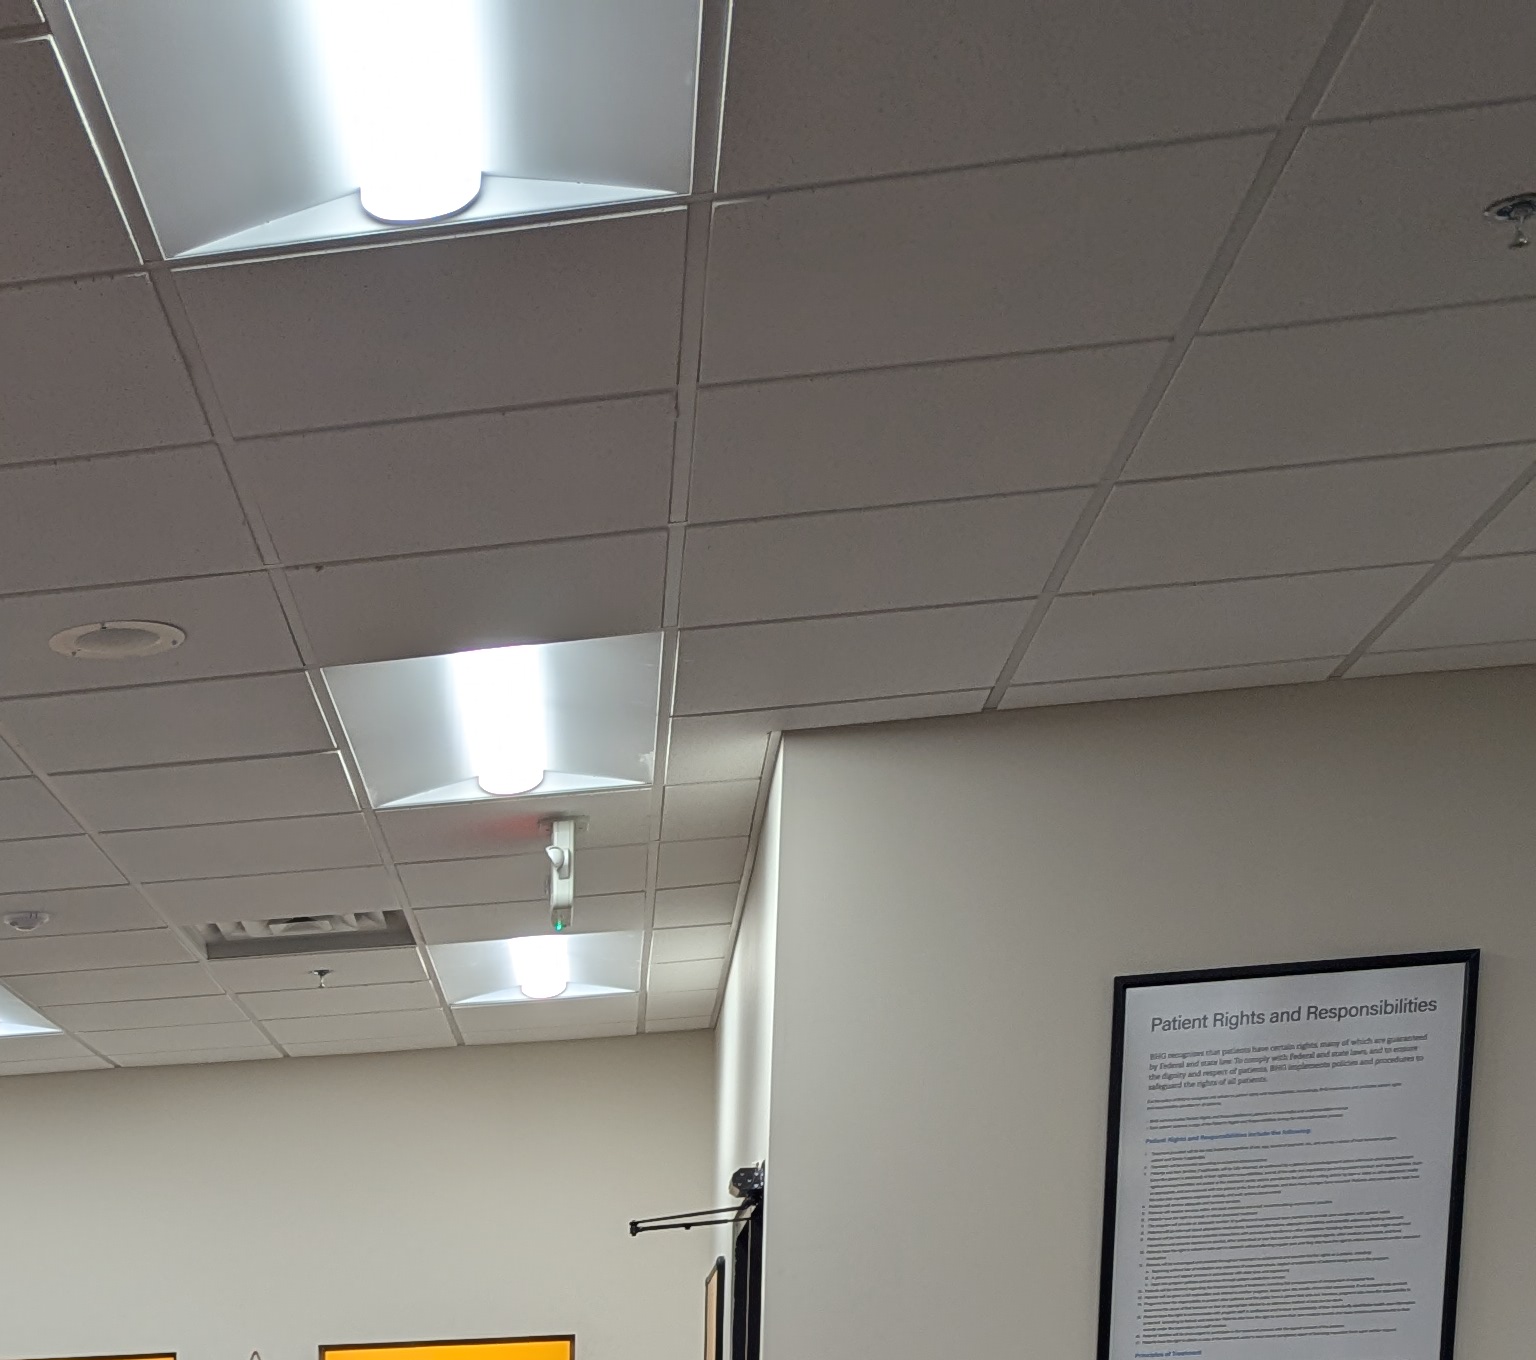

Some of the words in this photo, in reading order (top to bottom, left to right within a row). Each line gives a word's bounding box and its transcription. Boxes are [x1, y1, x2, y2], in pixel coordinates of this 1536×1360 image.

[1151, 1014, 1208, 1032] Patient
[1213, 1010, 1265, 1030] Rights
[1269, 1006, 1302, 1024] and
[1306, 997, 1438, 1022] Responsibilities
